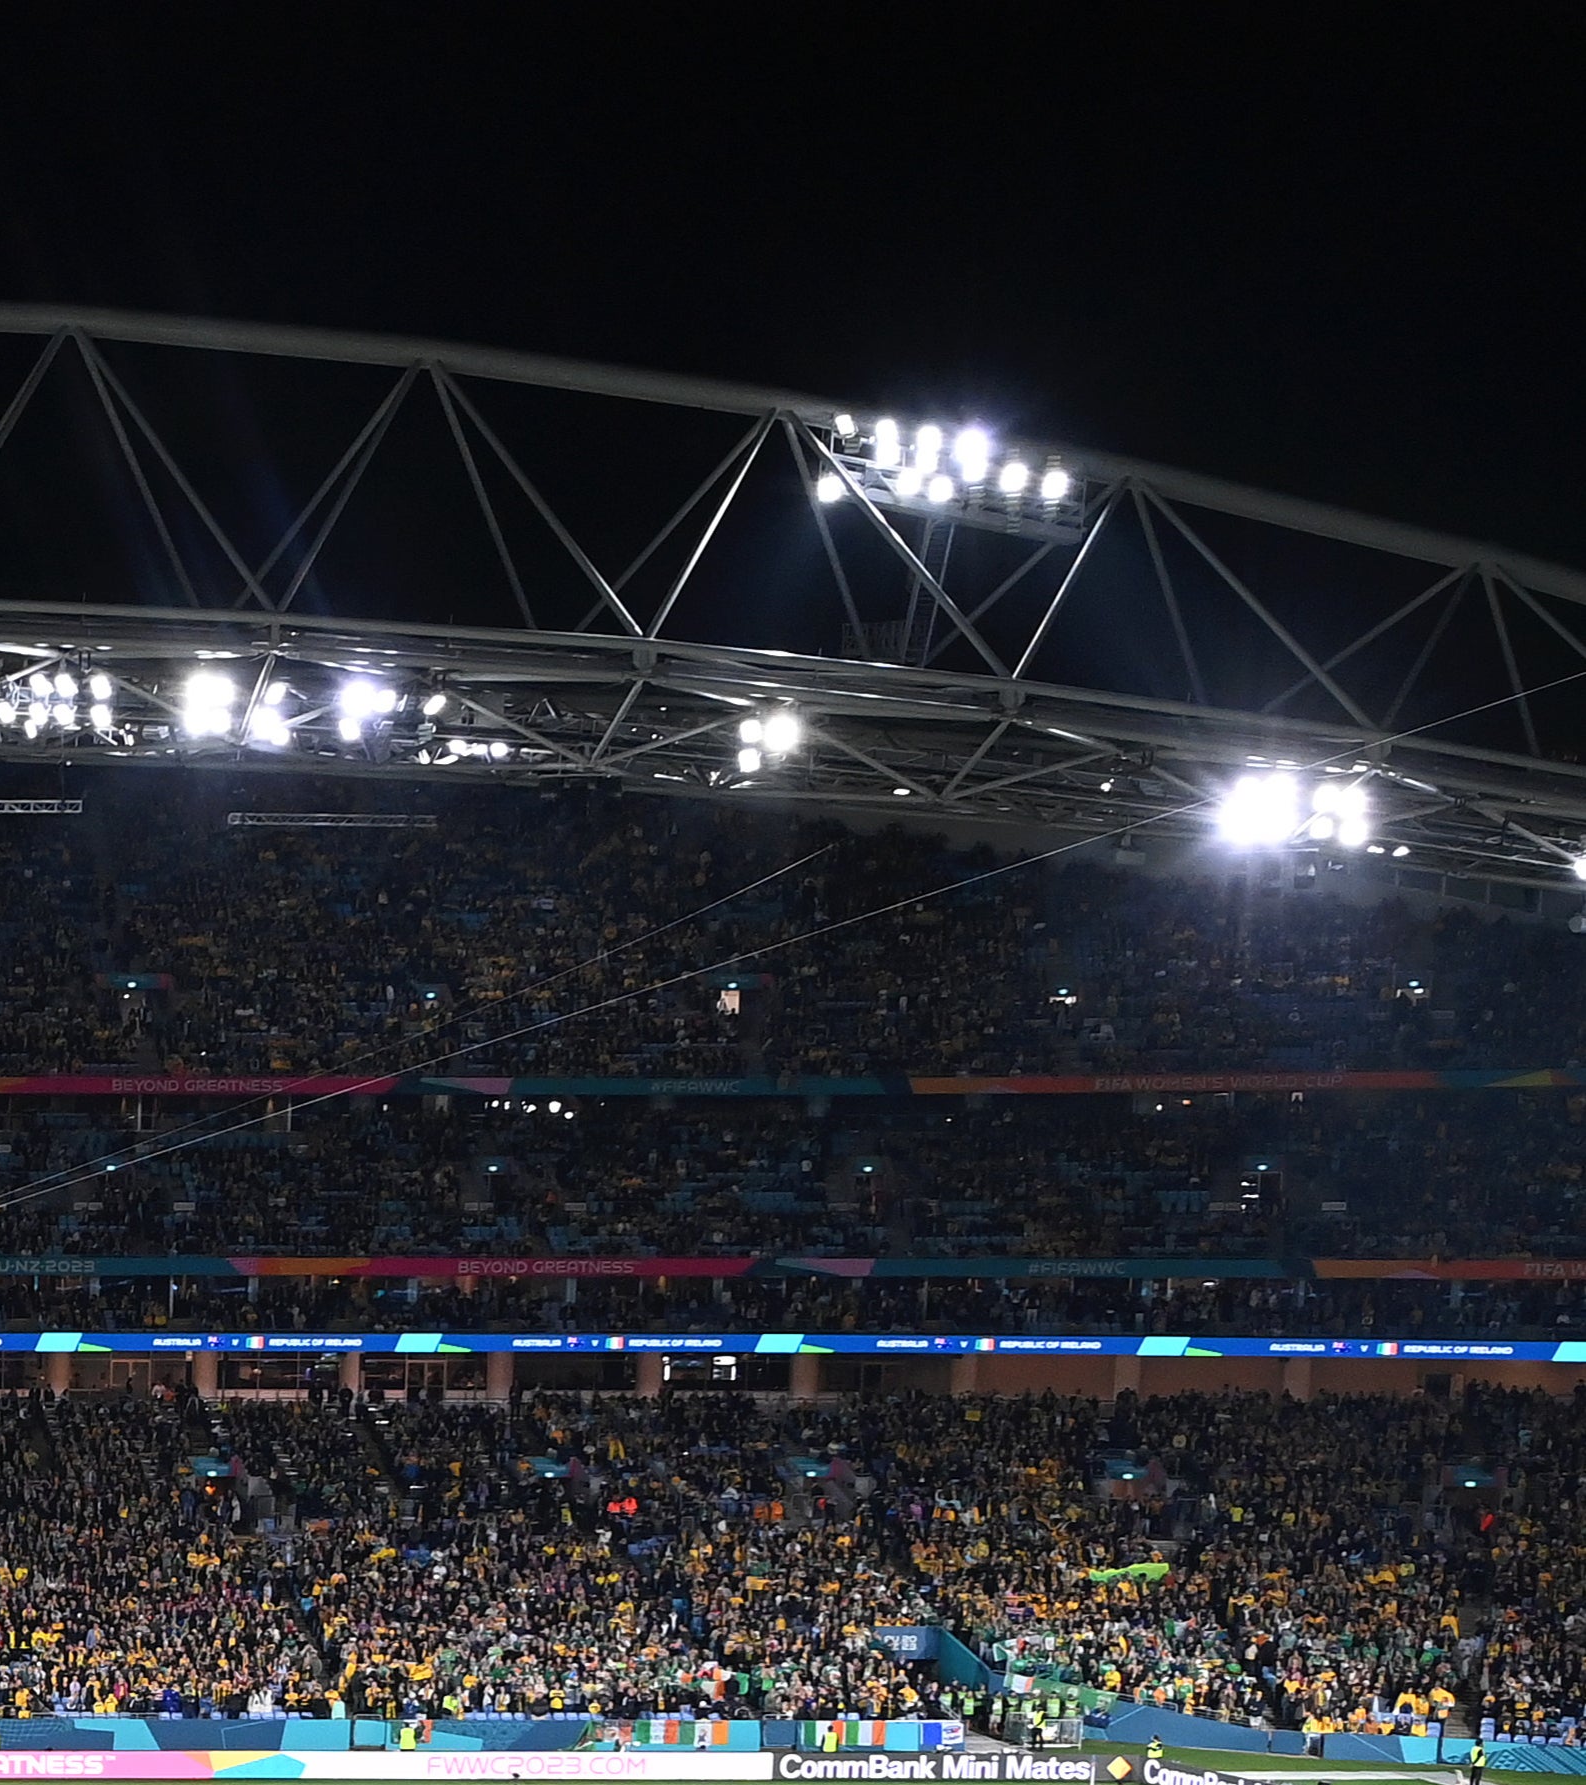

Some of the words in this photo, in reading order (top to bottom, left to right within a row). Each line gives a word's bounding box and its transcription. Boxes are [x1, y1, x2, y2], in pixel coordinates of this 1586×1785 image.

[112, 1079, 180, 1092] BEYOND
[184, 1079, 284, 1093] GREATNESS
[457, 1261, 528, 1275] BEYOND
[532, 1261, 635, 1275] GREATNESS
[152, 1338, 202, 1347] AUSTRALIA
[268, 1338, 311, 1347] REPUBLIC
[312, 1338, 324, 1347] OF
[325, 1338, 363, 1347] IRELAND
[512, 1338, 562, 1347] AUSTRALIA
[628, 1338, 671, 1347] REPUBLIC
[672, 1338, 684, 1347] OF
[685, 1338, 723, 1347] IRELAND
[876, 1339, 929, 1348] AUSTRALIA
[999, 1340, 1045, 1349] REPUBLIC
[1046, 1340, 1060, 1350] OF
[1061, 1340, 1102, 1350] IRELAND
[1269, 1343, 1326, 1352] AUSTRALIA
[1403, 1344, 1453, 1353] REPUBLIC
[1454, 1344, 1469, 1354] OF
[1469, 1345, 1514, 1355] IRELAND
[427, 1756, 647, 1776] FWWC2023.COM
[779, 1754, 931, 1781] CommBank
[933, 1754, 997, 1780] Mini
[1004, 1754, 1091, 1781] Mates
